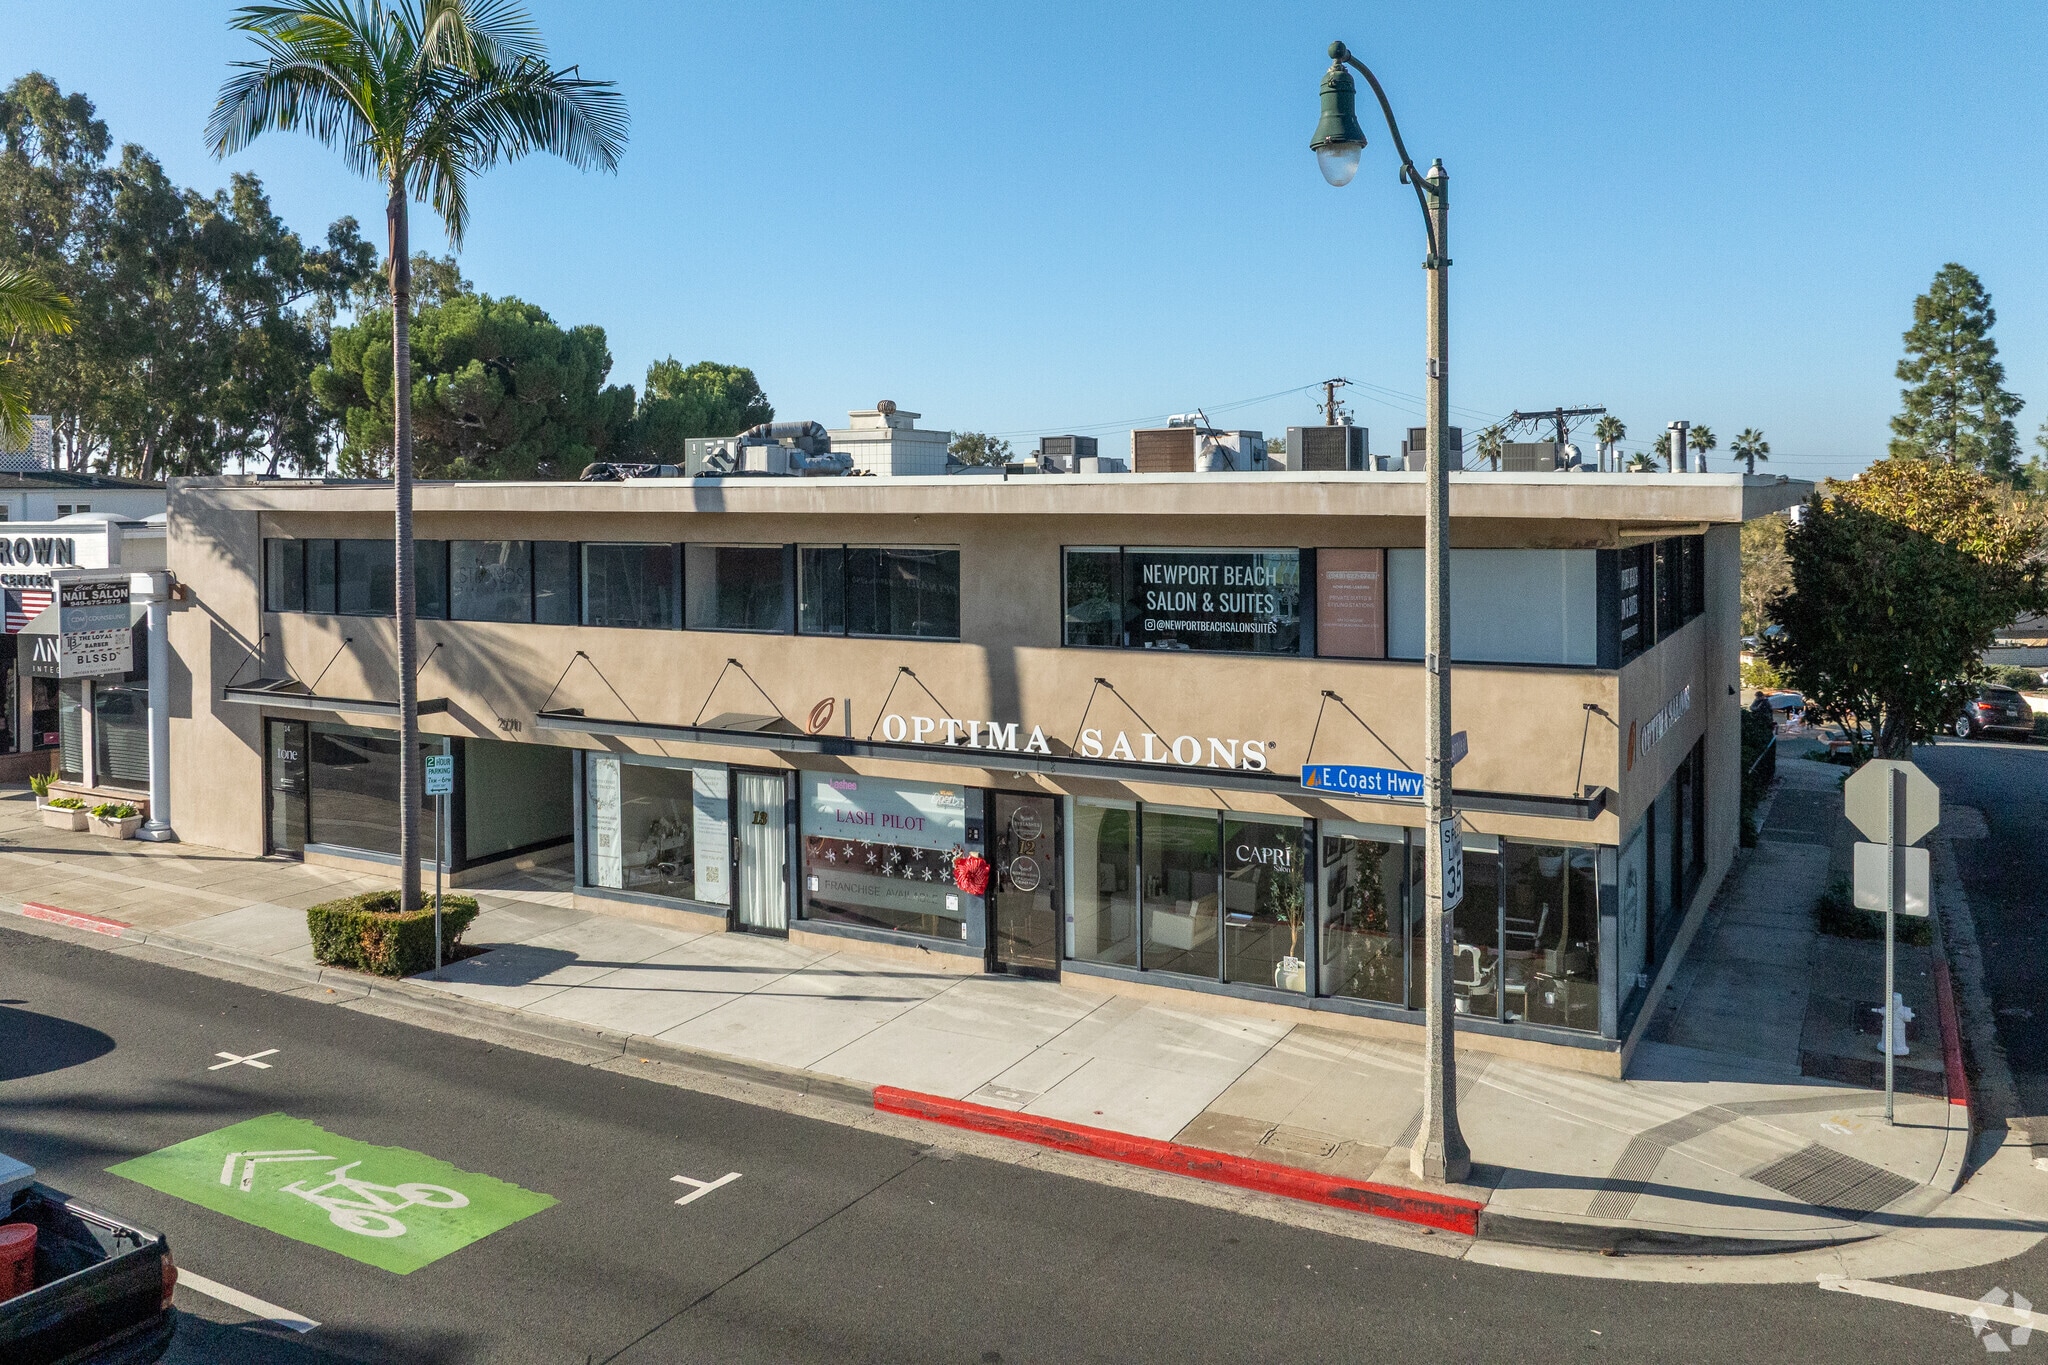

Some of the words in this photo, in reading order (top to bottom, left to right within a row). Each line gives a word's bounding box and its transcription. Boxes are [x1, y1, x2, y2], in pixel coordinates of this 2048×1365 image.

[1, 573, 53, 587] CENTER
[1143, 564, 1218, 585] NEWPORT
[1224, 565, 1277, 586] BEACH
[63, 591, 89, 601] NAIL
[92, 588, 128, 600] SALON
[1147, 591, 1196, 612] SALON
[1202, 592, 1214, 613] &
[1219, 593, 1274, 614] SUITES
[1157, 619, 1277, 634] @NEWPORTBEACHSALONSUITES
[77, 652, 117, 664] BLSSD
[882, 714, 1052, 755] OPTIMA
[436, 757, 451, 766] HOUR
[1387, 772, 1422, 796] Hwy
[751, 810, 768, 825] 13
[836, 809, 874, 826] LASH
[882, 813, 926, 831] PILOT
[1019, 840, 1036, 855] 12
[1447, 859, 1462, 899] 35
[825, 880, 881, 897] FRANCHISE
